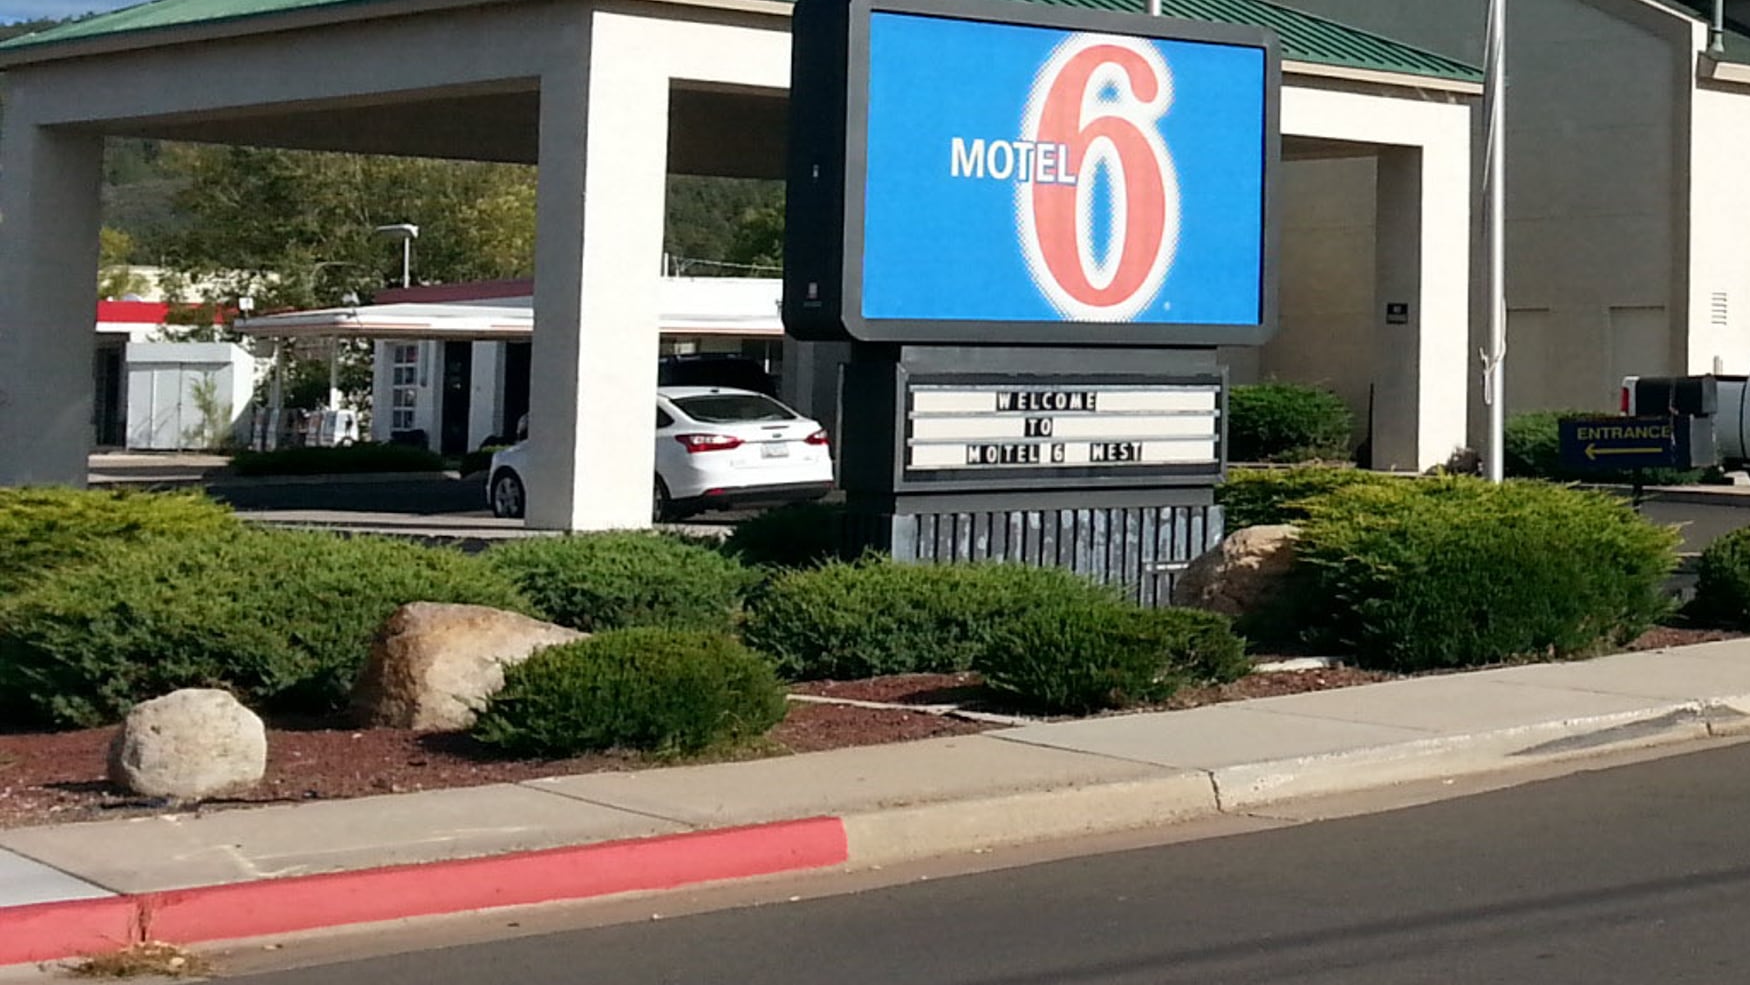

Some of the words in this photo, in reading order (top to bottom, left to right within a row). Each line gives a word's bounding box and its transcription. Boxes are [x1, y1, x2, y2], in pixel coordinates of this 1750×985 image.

[951, 136, 1077, 185] MOTEL
[1030, 42, 1168, 309] 6
[999, 391, 1096, 410] WELCOME
[1028, 418, 1052, 435] TO
[1576, 425, 1673, 441] ENTRANCE
[968, 444, 1040, 463] MOTEL
[1053, 444, 1064, 462] 6
[1091, 442, 1142, 462] WEST
